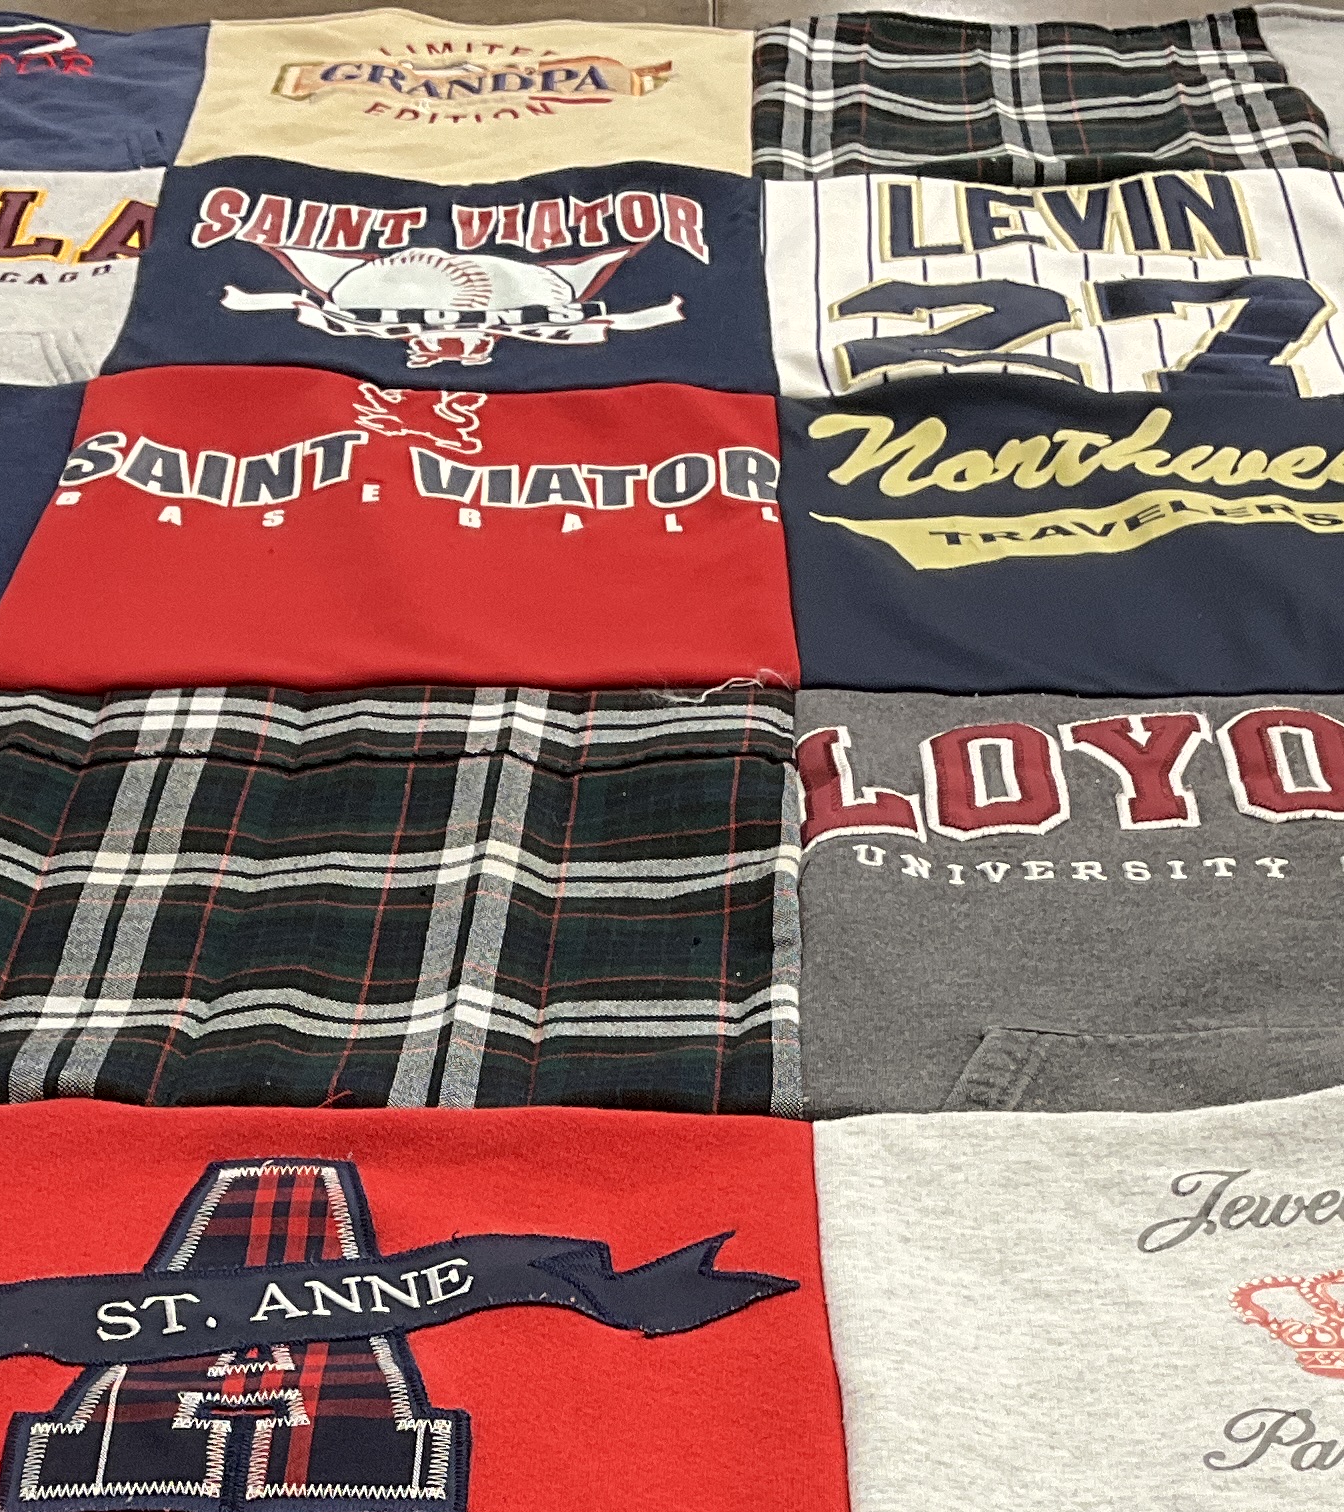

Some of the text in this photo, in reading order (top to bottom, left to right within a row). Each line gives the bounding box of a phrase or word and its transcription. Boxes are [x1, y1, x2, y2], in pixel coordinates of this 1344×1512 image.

[320, 62, 618, 100] GRANDPA
[191, 187, 711, 265] SAINT VIATOR
[877, 170, 1261, 263] LEVIN
[828, 276, 1338, 399] 27
[57, 430, 782, 508] SAINT VIATOR
[852, 843, 1290, 885] UNIVERSITY
[94, 1256, 475, 1344] ST. ANNE
